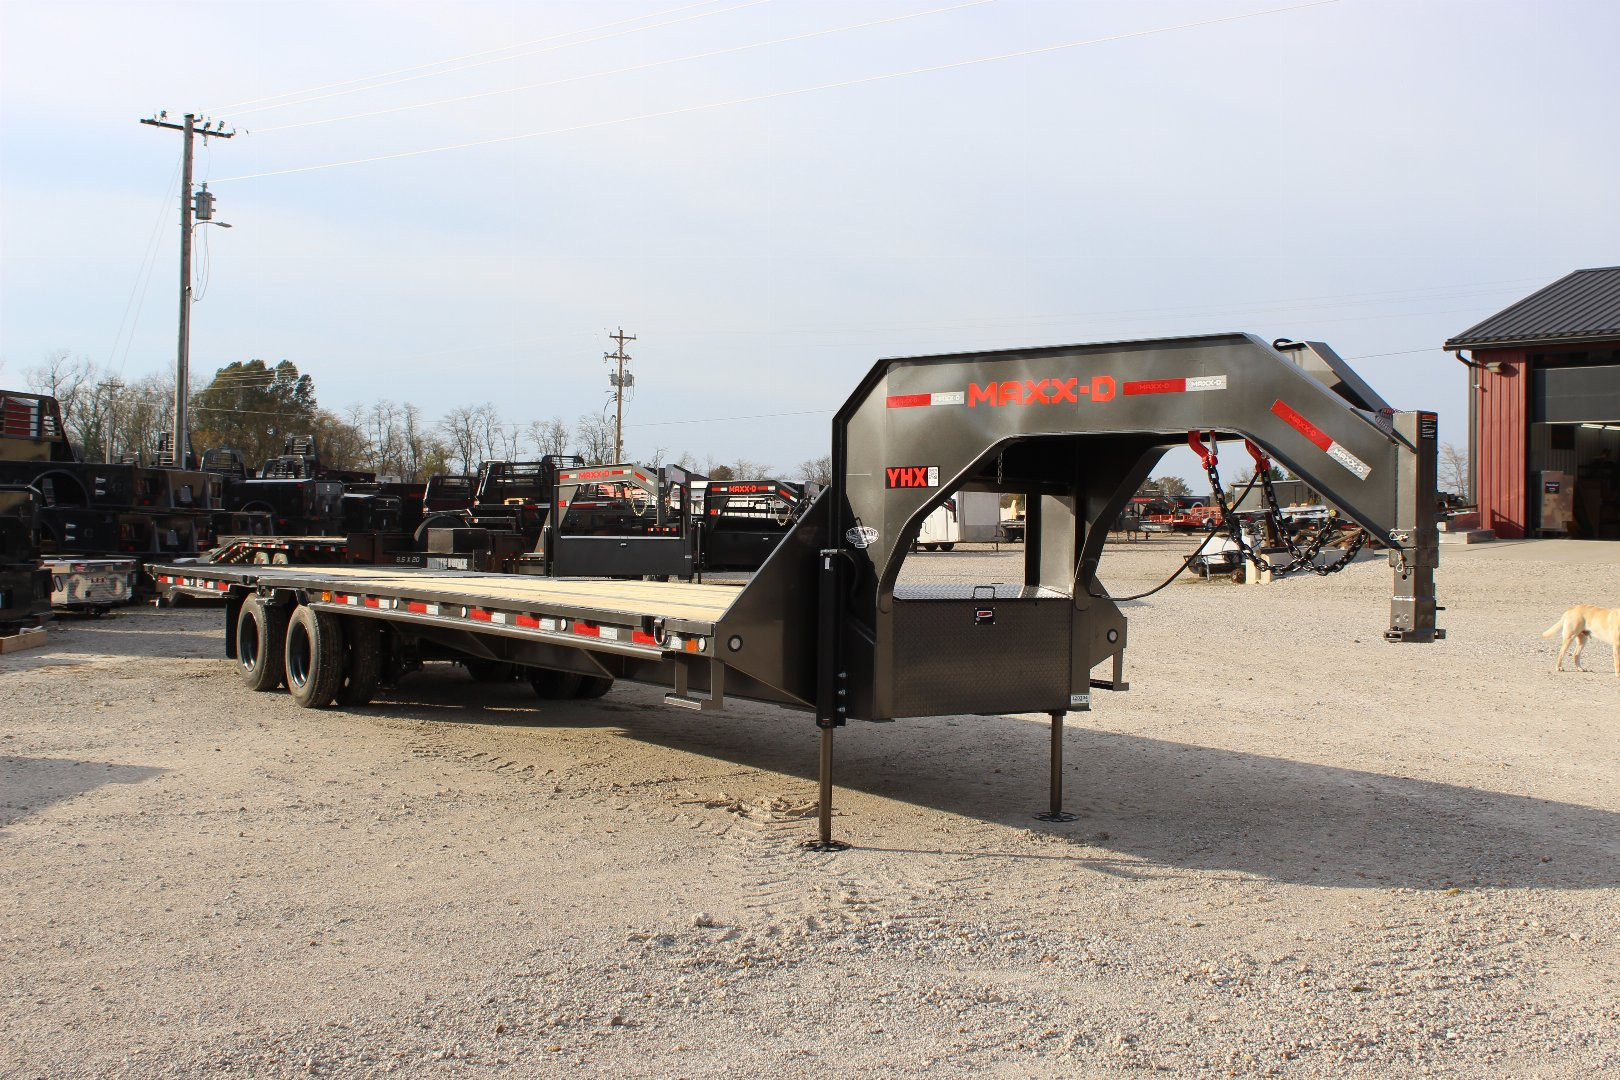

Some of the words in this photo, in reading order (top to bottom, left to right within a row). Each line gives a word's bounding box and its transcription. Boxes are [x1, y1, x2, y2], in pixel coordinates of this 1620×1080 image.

[967, 375, 1116, 408] MAXX-D
[1138, 382, 1170, 391] MAXX-D
[1190, 379, 1222, 389] MAXX-D
[1288, 414, 1317, 437] MAXX-D
[1333, 448, 1364, 473] MAXX-D
[578, 469, 610, 480] MAXX-D
[886, 467, 927, 488] YHX
[728, 484, 757, 493] MAXX-D
